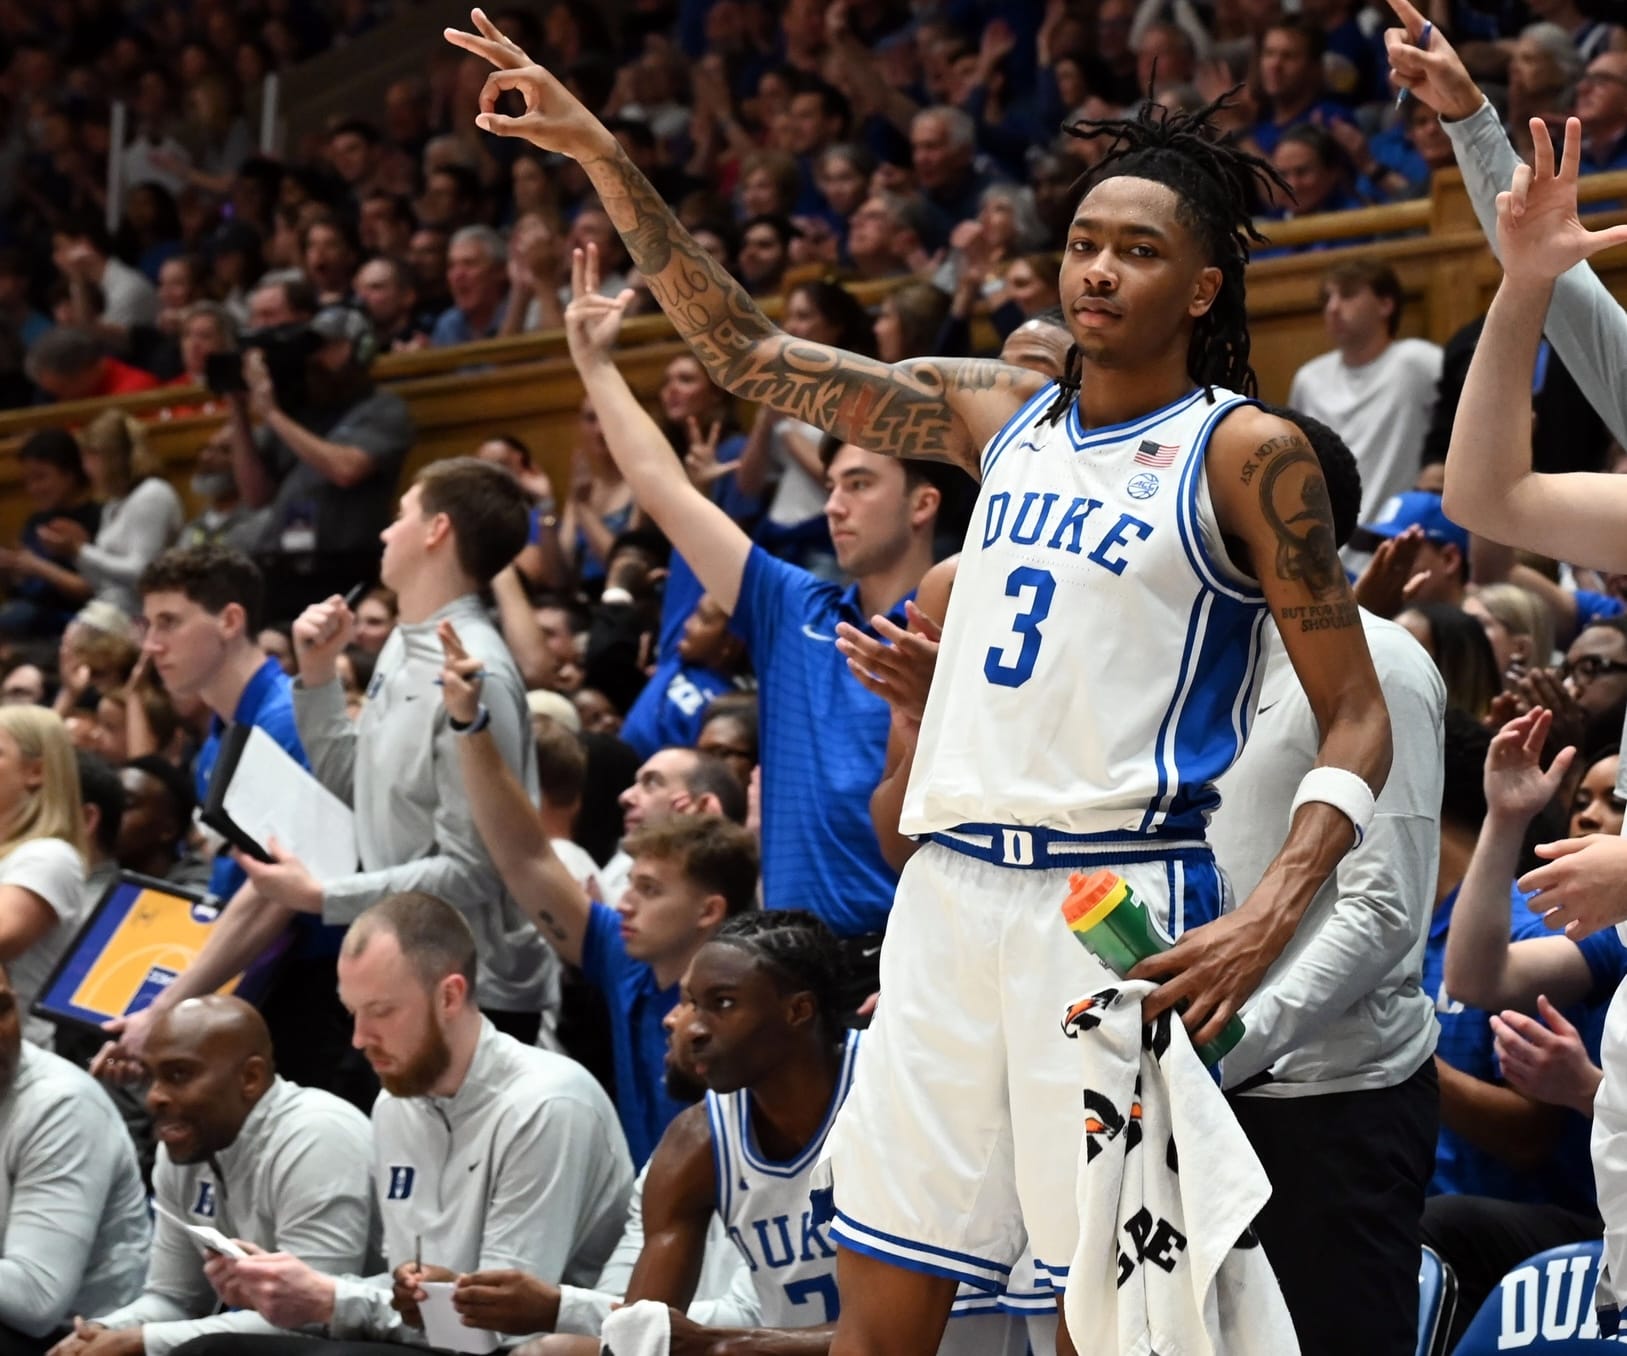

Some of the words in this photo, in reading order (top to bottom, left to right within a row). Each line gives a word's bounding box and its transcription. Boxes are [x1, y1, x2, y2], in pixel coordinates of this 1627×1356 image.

[982, 491, 1154, 576] DUKE
[984, 566, 1056, 688] 3
[1002, 828, 1034, 865] D
[728, 1211, 837, 1272] DUK
